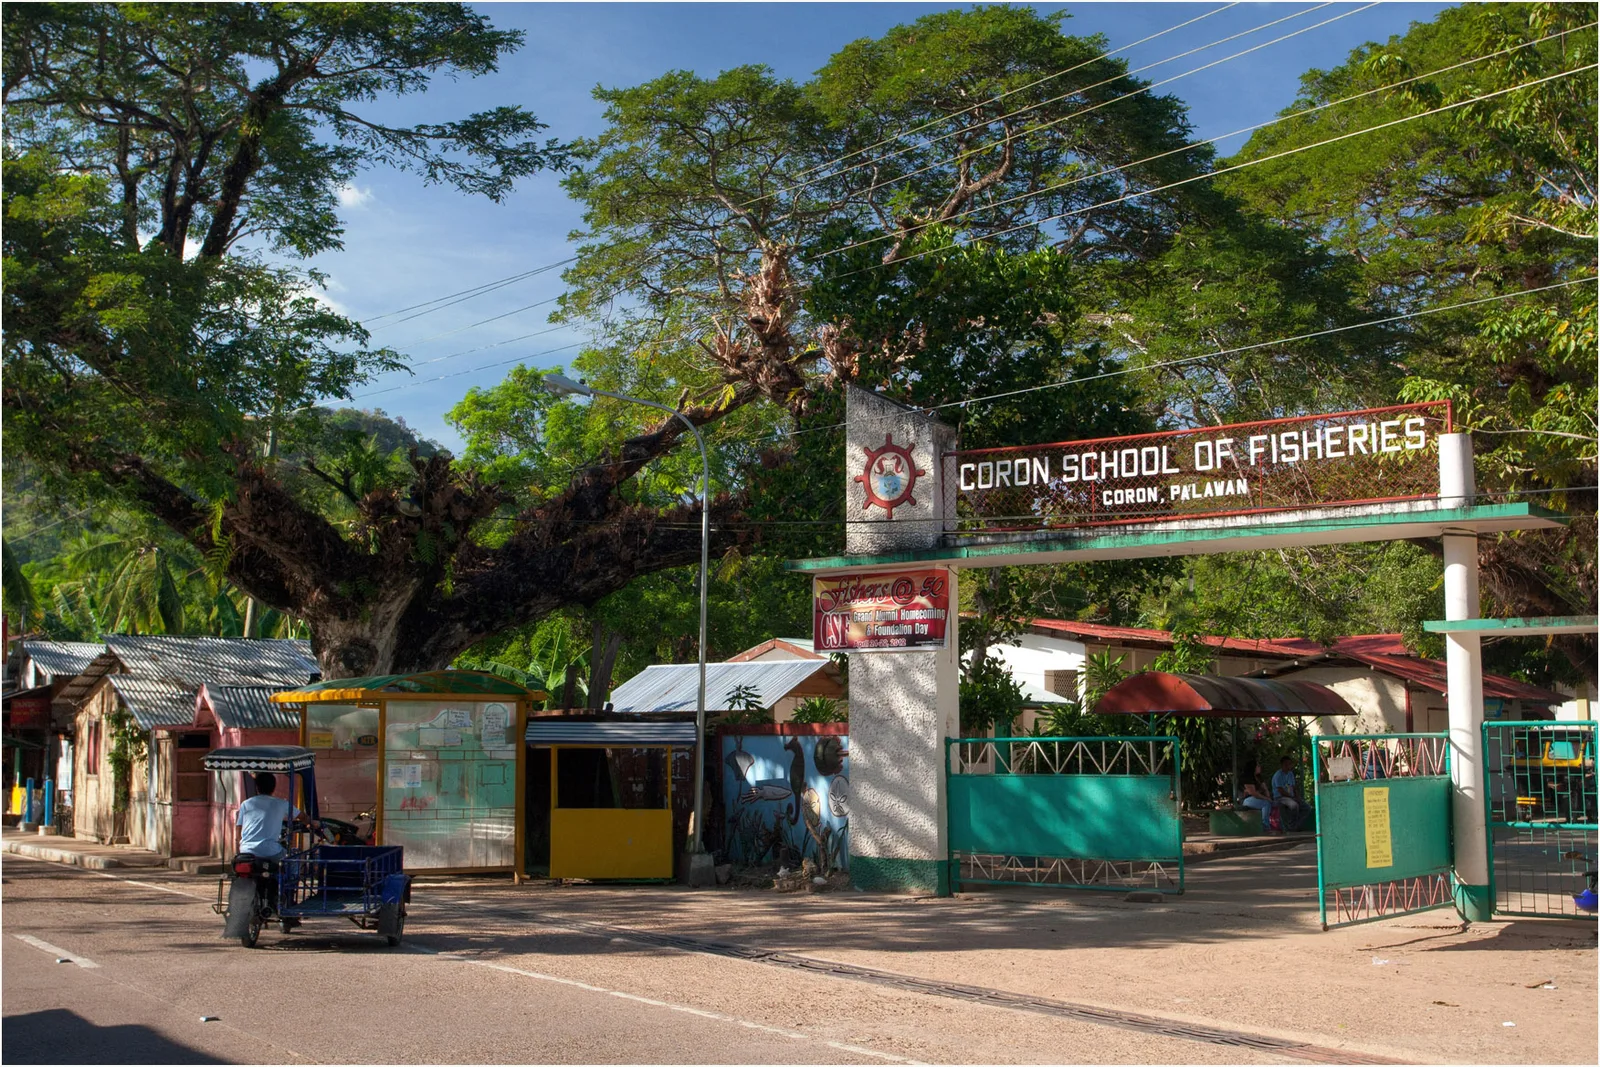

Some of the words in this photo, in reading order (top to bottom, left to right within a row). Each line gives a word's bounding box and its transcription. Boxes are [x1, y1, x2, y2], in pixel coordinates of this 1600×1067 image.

[960, 456, 1049, 491] CORON
[1062, 446, 1180, 483] SCHOOL
[1194, 438, 1234, 471] OF
[1249, 418, 1425, 466] FISHERIES
[1102, 487, 1165, 506] CORON,
[1170, 478, 1248, 502] PALAWAN
[891, 576, 917, 606] @
[920, 576, 944, 598] 50
[853, 610, 873, 622] Grand
[876, 608, 898, 622] Alumni
[901, 607, 946, 621] Homecoming
[866, 625, 872, 636] &
[874, 623, 912, 636] Foundation
[915, 622, 929, 636] Day
[821, 611, 851, 648] CSF
